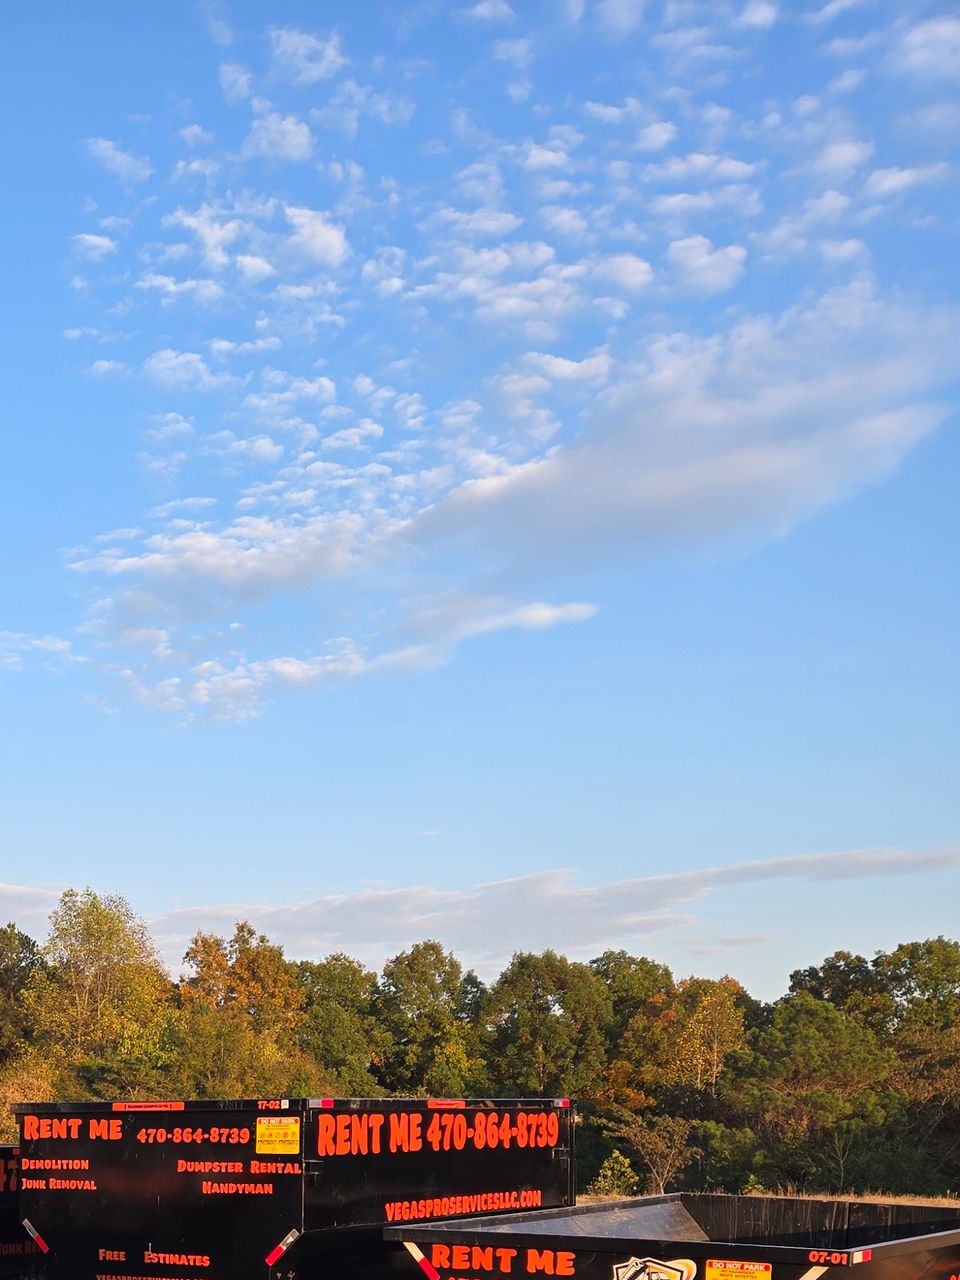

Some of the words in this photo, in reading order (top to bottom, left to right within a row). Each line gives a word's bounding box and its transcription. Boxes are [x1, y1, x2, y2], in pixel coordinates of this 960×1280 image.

[257, 1100, 280, 1109] 17-02
[23, 1115, 82, 1140] RENT
[89, 1119, 123, 1140] ME
[136, 1127, 251, 1144] 470-864-8739
[317, 1113, 385, 1157] RENT
[389, 1113, 423, 1152] ME
[426, 1111, 559, 1151] 470-864-8739
[21, 1158, 89, 1171] DEMOLITION
[177, 1160, 243, 1173] DUMPSTER
[250, 1160, 302, 1174] RENTAL
[21, 1177, 46, 1190] JUNK
[49, 1177, 97, 1191] REMOVAL
[202, 1181, 273, 1194] HANDYMAN
[385, 1190, 541, 1222] VEGASPROSERVICESLLC.COM
[98, 1249, 126, 1261] FREE
[144, 1251, 210, 1267] ESTIMATES
[431, 1244, 517, 1274] RENT
[526, 1249, 576, 1276] ME
[808, 1250, 849, 1265] 07-01
